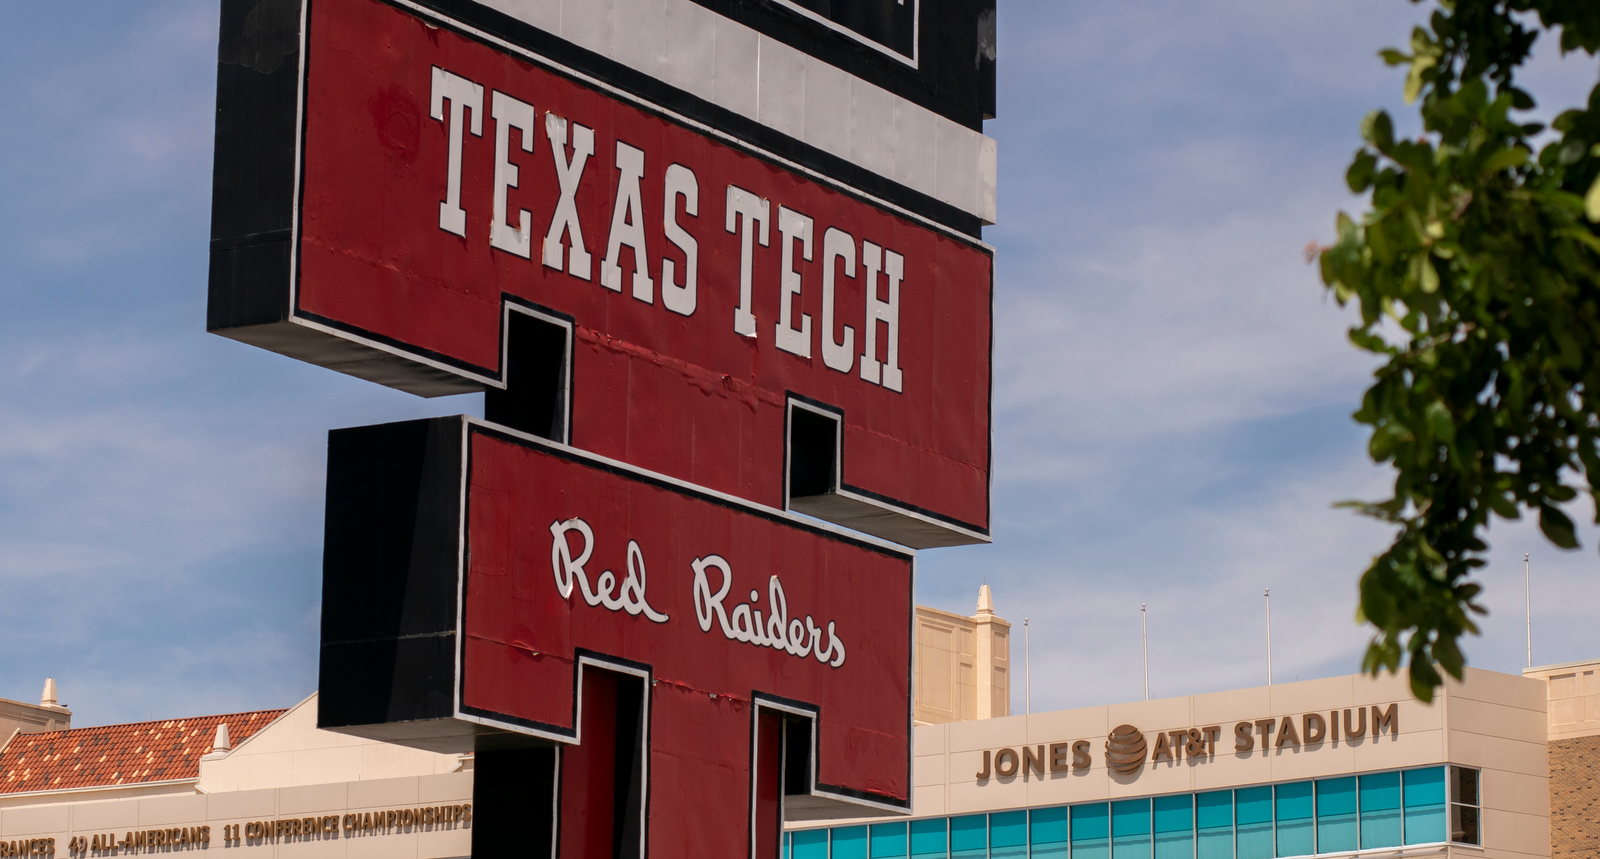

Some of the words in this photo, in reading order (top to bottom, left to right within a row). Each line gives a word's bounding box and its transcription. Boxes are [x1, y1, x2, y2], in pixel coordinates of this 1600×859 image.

[430, 65, 699, 317] TEXAS
[725, 183, 905, 394] TECH
[549, 517, 670, 623] Red
[690, 554, 847, 668] Raiders
[976, 739, 1092, 780] JONES
[1152, 725, 1221, 761] AT&T
[1234, 703, 1398, 752] STADIUM
[68, 835, 87, 854] 49
[91, 825, 210, 852] ALL-AMERICANS
[223, 824, 240, 842] 11
[245, 814, 340, 841] CONFERENCE
[343, 803, 472, 832] CHAMPIONSHIPS
